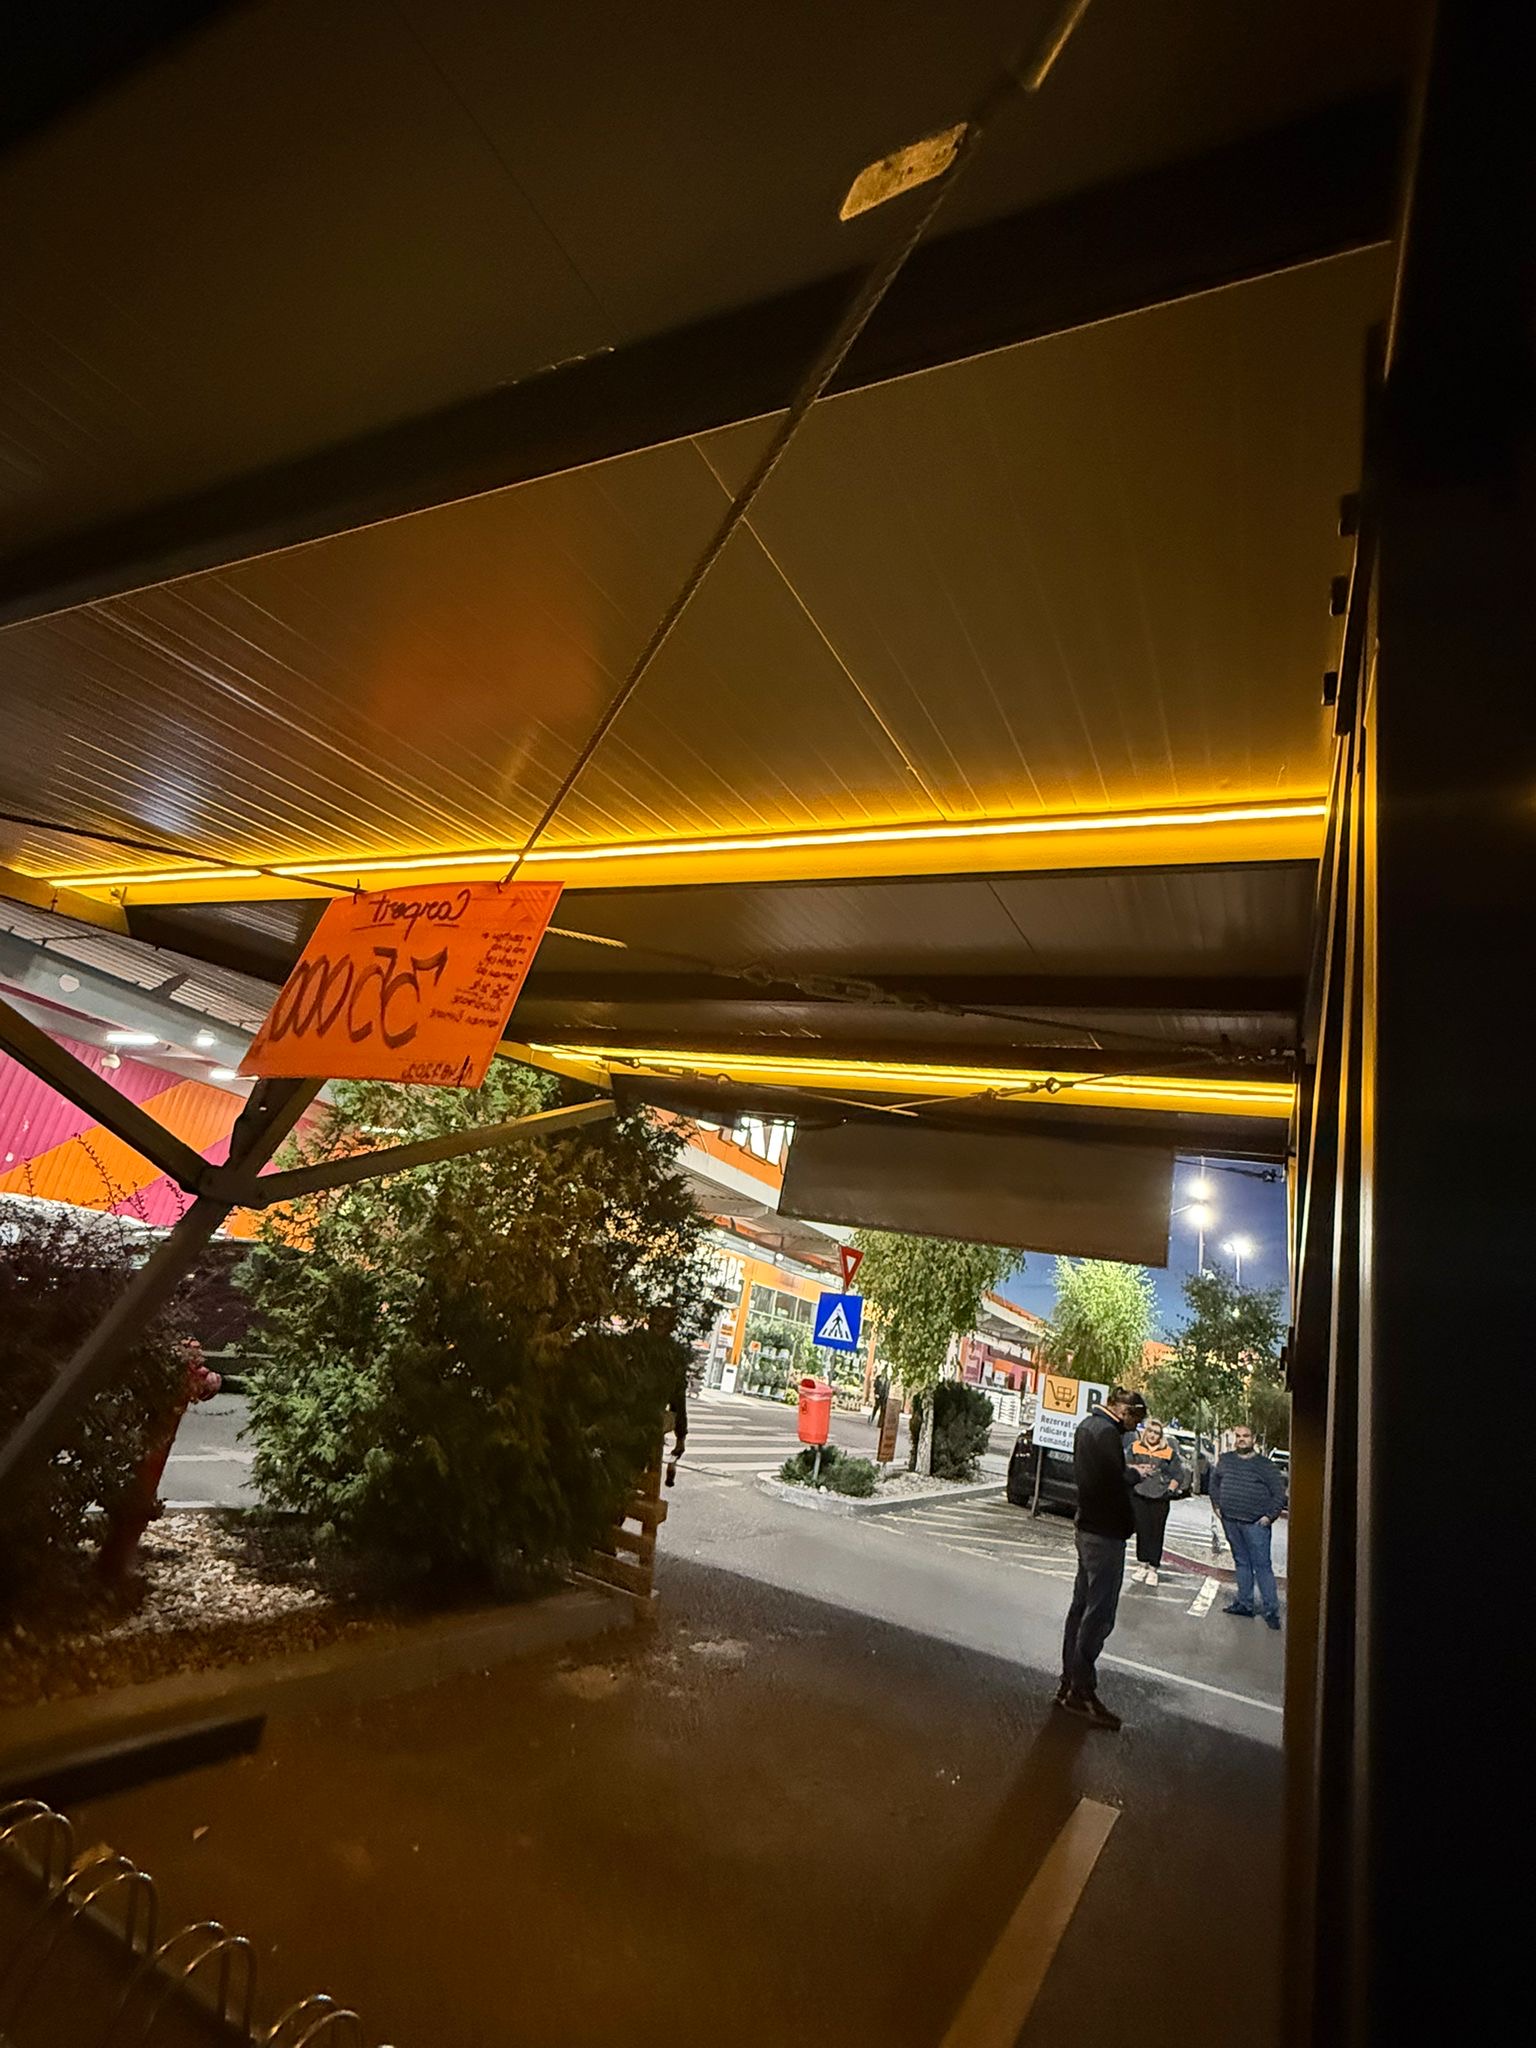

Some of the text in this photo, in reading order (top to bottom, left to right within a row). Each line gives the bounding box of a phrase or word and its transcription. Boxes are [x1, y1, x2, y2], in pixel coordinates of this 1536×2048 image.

[1086, 1388, 1102, 1413] P
[1040, 1414, 1071, 1428] Rezervat
[1039, 1425, 1068, 1438] ridicare
